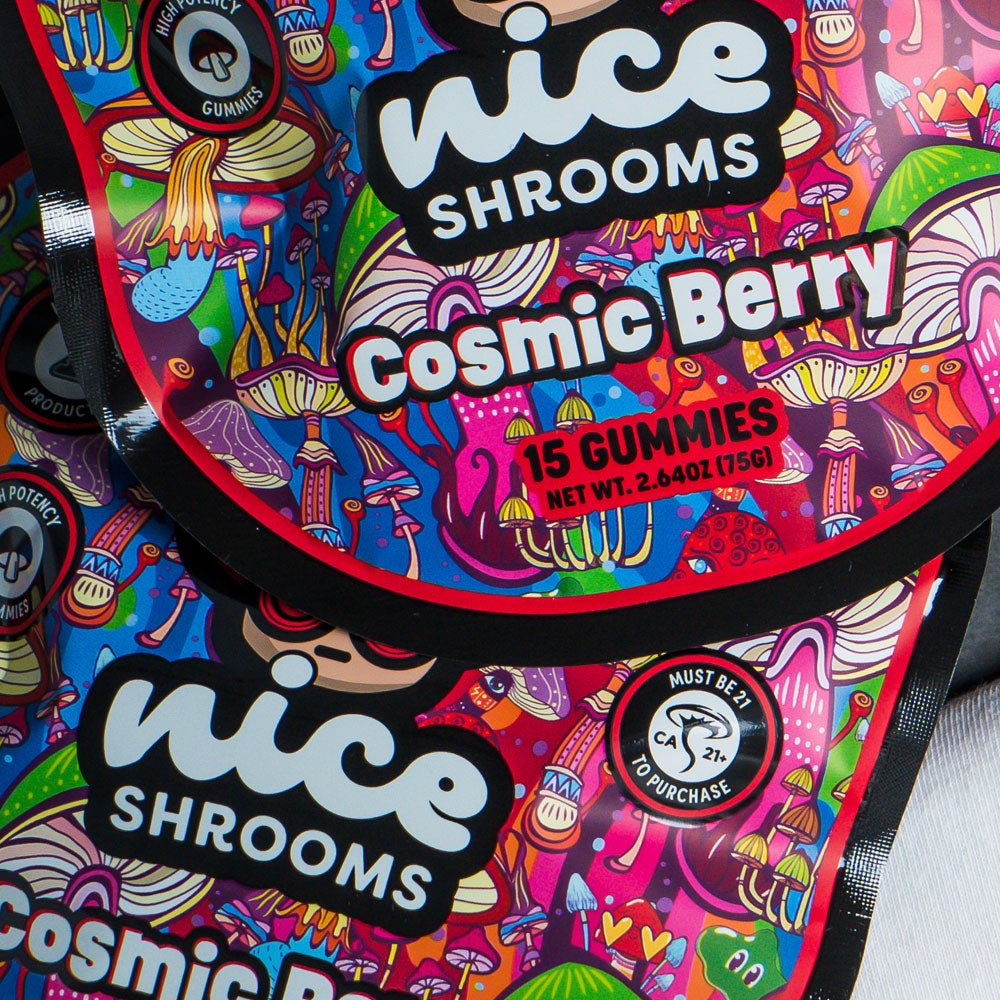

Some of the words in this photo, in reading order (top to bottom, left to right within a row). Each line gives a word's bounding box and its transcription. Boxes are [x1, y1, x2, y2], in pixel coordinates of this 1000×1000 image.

[156, 1, 180, 37] HIGH
[202, 85, 264, 118] GUMMIES
[379, 6, 771, 189] nice
[427, 133, 759, 239] SHROOMS
[347, 292, 654, 404] Cosmic
[664, 236, 898, 346] Berry
[24, 387, 90, 417] PRODUC
[523, 438, 571, 483] 15
[578, 397, 779, 472] GUMMIES
[9, 485, 63, 527] POTENCY
[546, 483, 586, 511] NET
[591, 475, 633, 500] WT.
[635, 458, 714, 493] 2.64OZ
[716, 446, 774, 478] (75G)
[669, 668, 715, 689] MUST
[714, 674, 739, 696] BE
[732, 690, 752, 710] 21
[104, 654, 488, 852] nice
[653, 730, 677, 750] CA
[702, 746, 728, 763] 21+
[631, 753, 652, 777] TO
[646, 776, 732, 804] PURCHASE
[110, 785, 432, 910] SHROOMS
